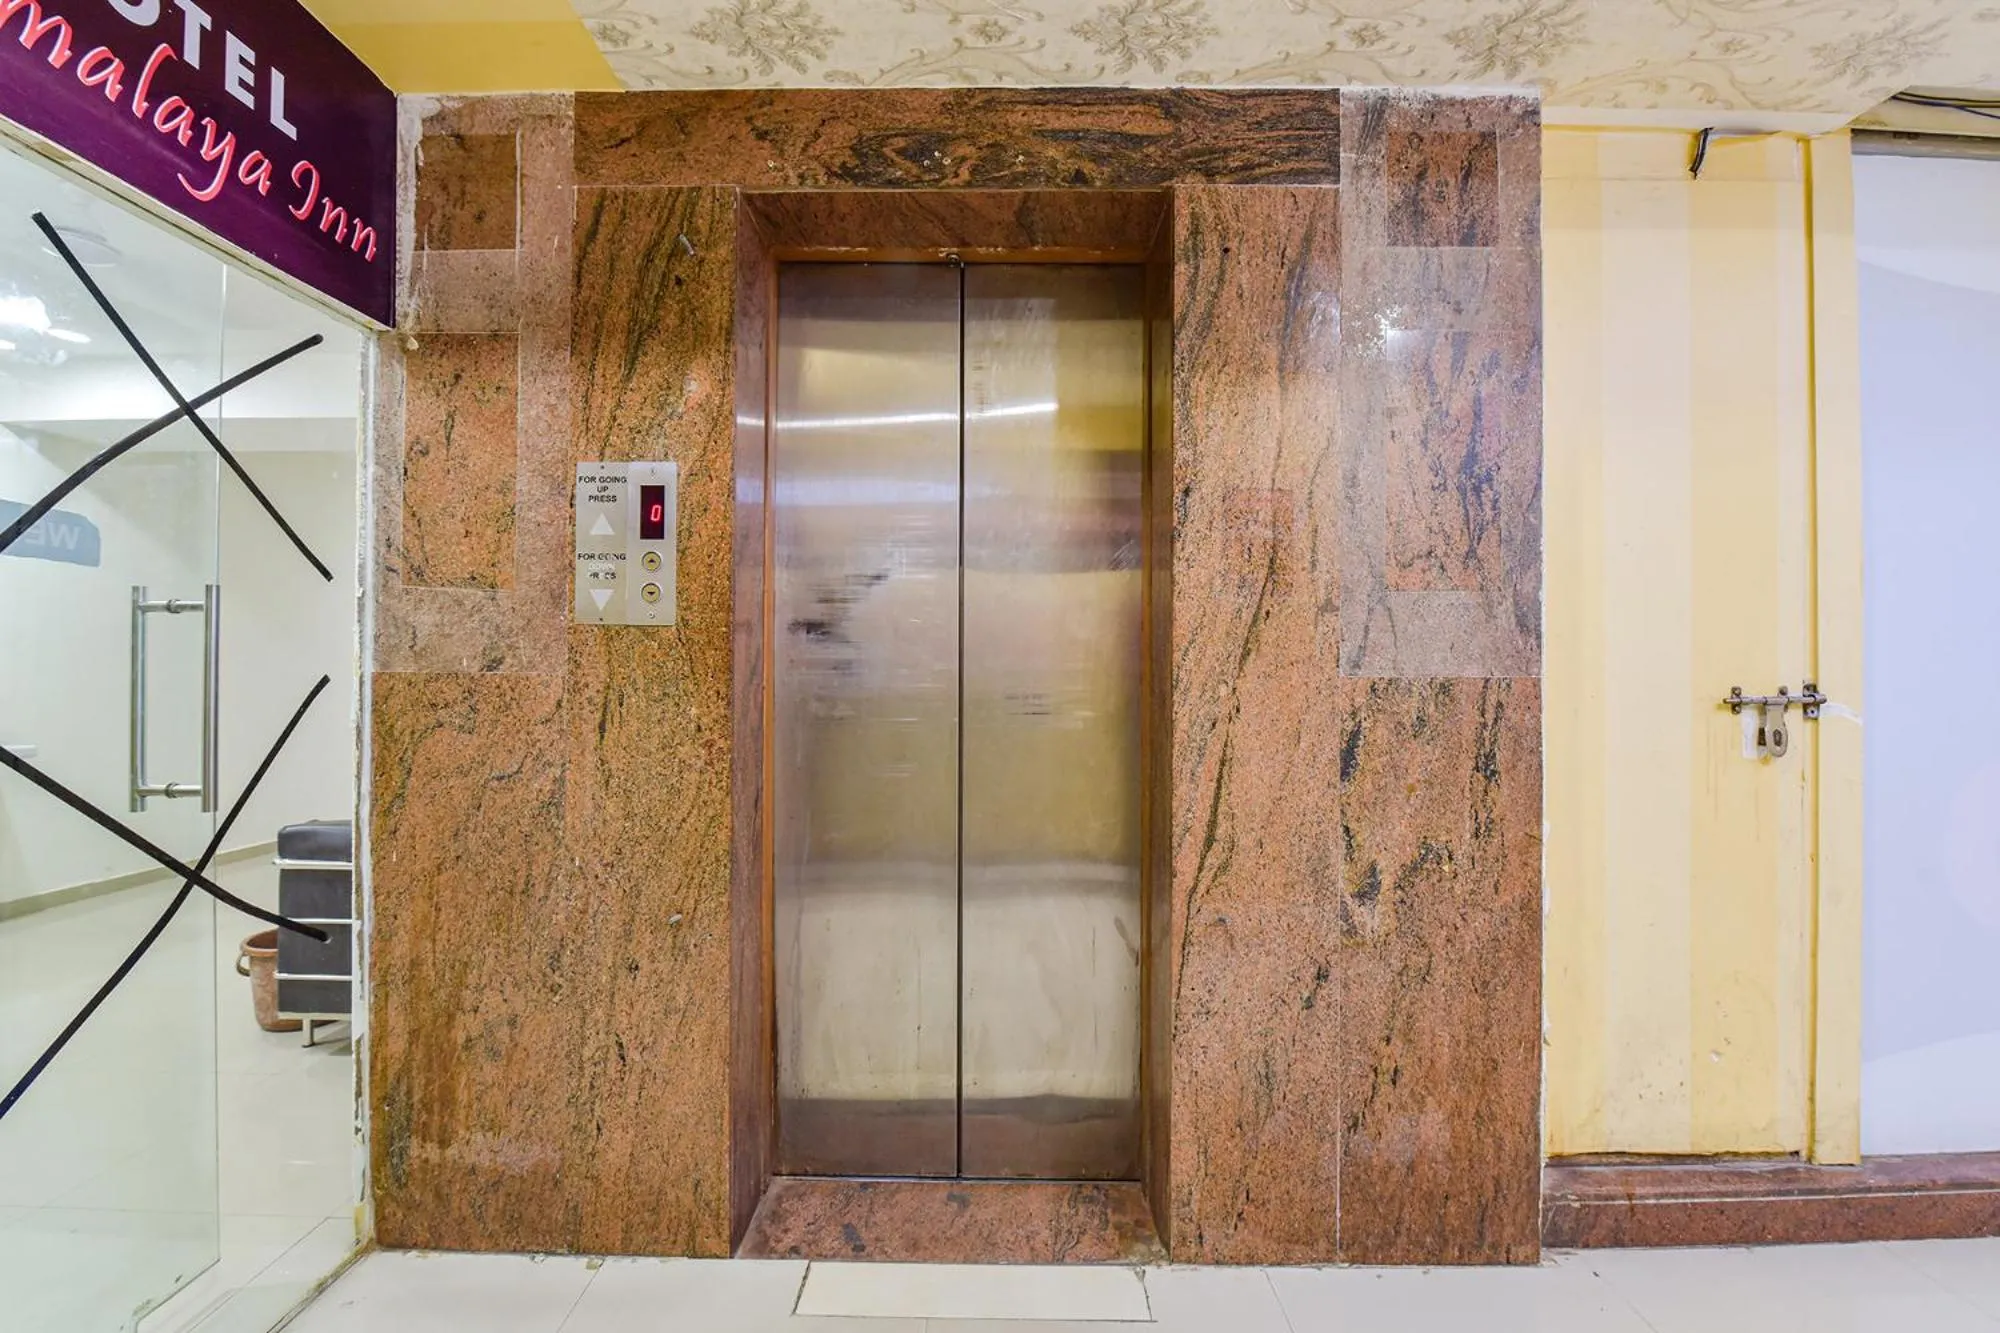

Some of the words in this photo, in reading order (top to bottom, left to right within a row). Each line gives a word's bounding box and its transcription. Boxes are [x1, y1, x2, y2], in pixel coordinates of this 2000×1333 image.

[289, 160, 377, 262] Inn
[578, 475, 596, 484] FOR
[598, 475, 628, 484] GOING
[596, 485, 609, 493] UP
[588, 494, 617, 503] PRESS
[577, 552, 596, 561] FOR
[597, 552, 626, 561] GONG
